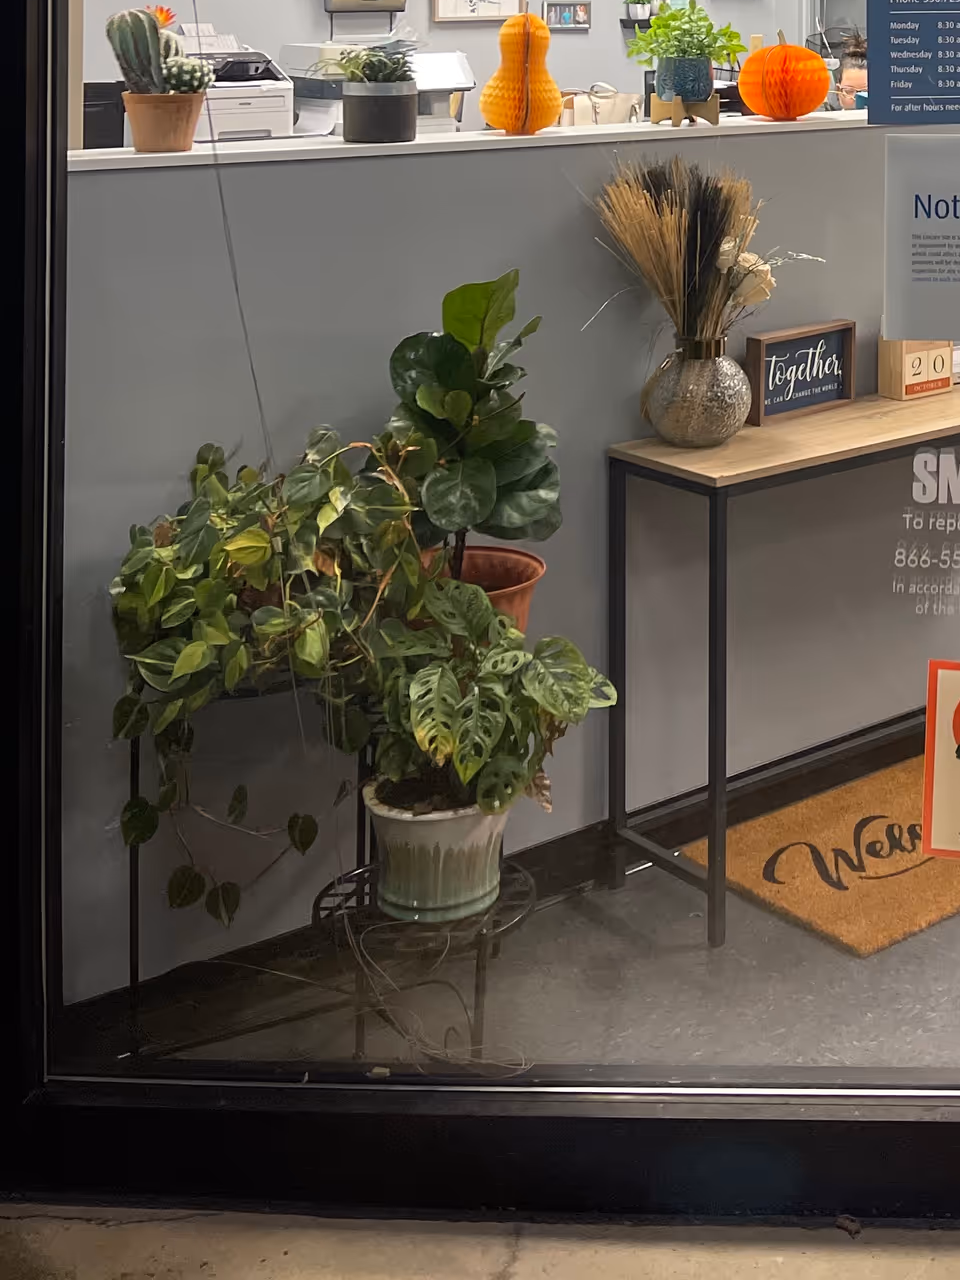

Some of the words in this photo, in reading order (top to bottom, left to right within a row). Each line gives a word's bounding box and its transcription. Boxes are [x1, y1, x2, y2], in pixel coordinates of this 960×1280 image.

[890, 21, 919, 31] Monday
[890, 36, 919, 46] Tuesday
[890, 50, 932, 60] Wednesday
[890, 65, 922, 75] Thursday
[890, 80, 912, 90] Friday
[891, 104, 902, 112] For
[904, 103, 921, 112] after
[923, 103, 944, 112] hours
[913, 381, 944, 392] OCTOBER
[792, 390, 811, 399] CHANGE
[812, 386, 821, 394] THE
[903, 513, 923, 530] To
[892, 581, 904, 595] In
[915, 600, 929, 615] of
[933, 600, 954, 615] the
